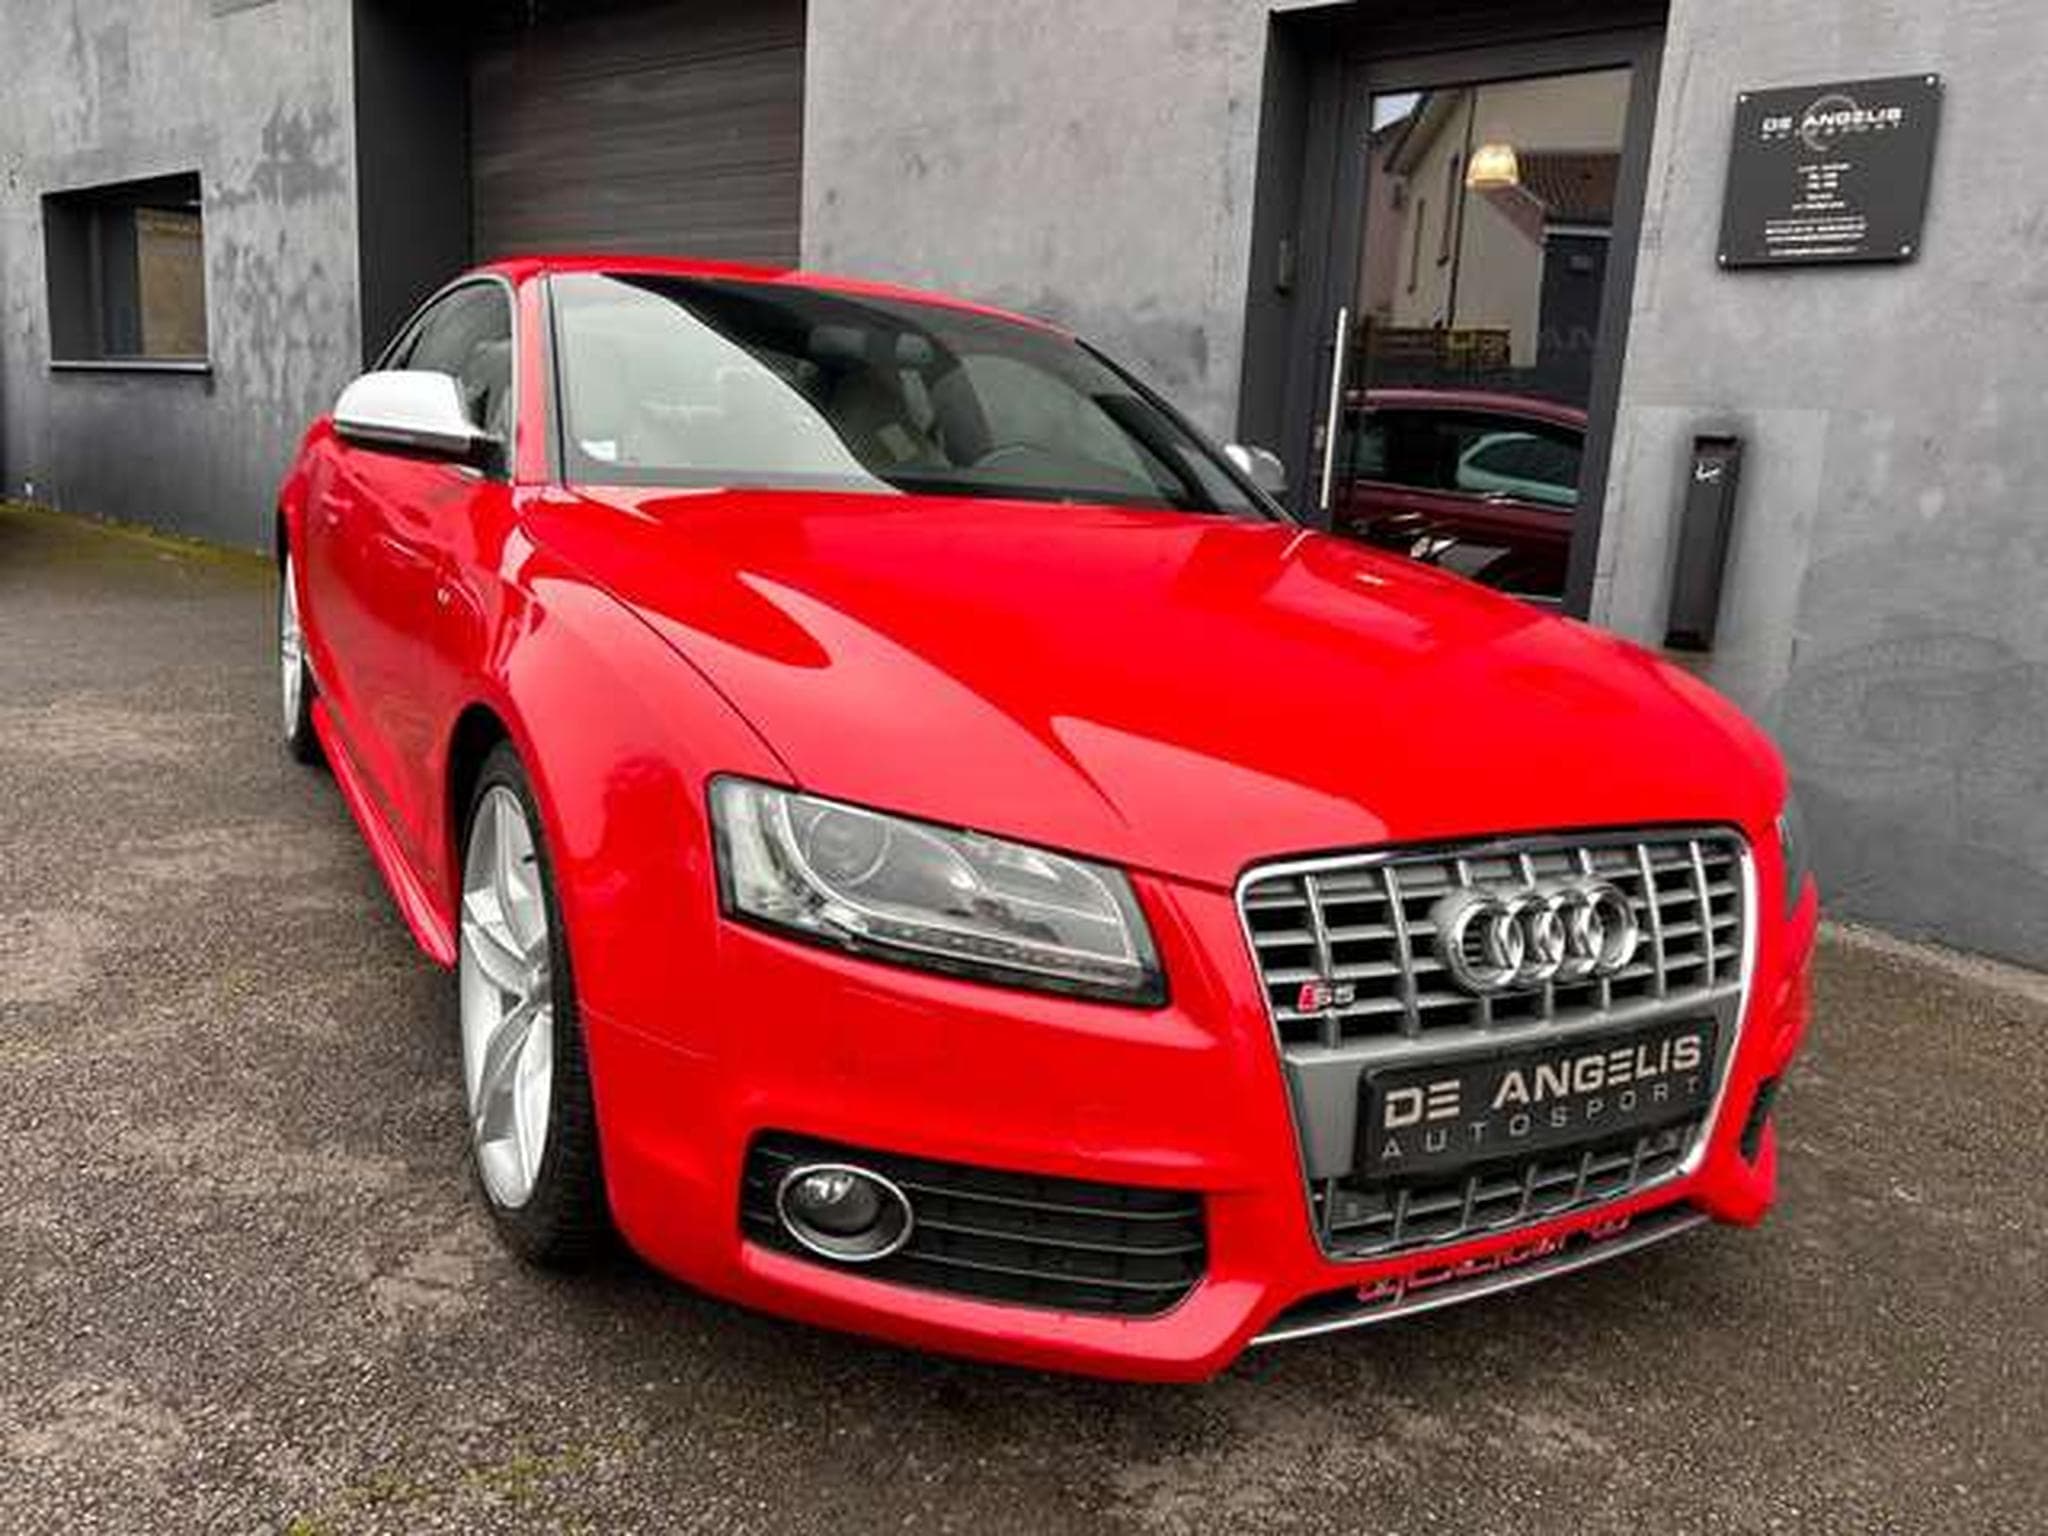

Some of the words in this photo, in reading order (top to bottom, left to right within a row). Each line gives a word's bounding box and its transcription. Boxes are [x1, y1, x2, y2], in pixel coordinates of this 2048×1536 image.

[1381, 1077, 1700, 1158] AUTOSPORT
[1384, 1079, 1461, 1129] DE
[1490, 1035, 1701, 1110] ANGELIS
